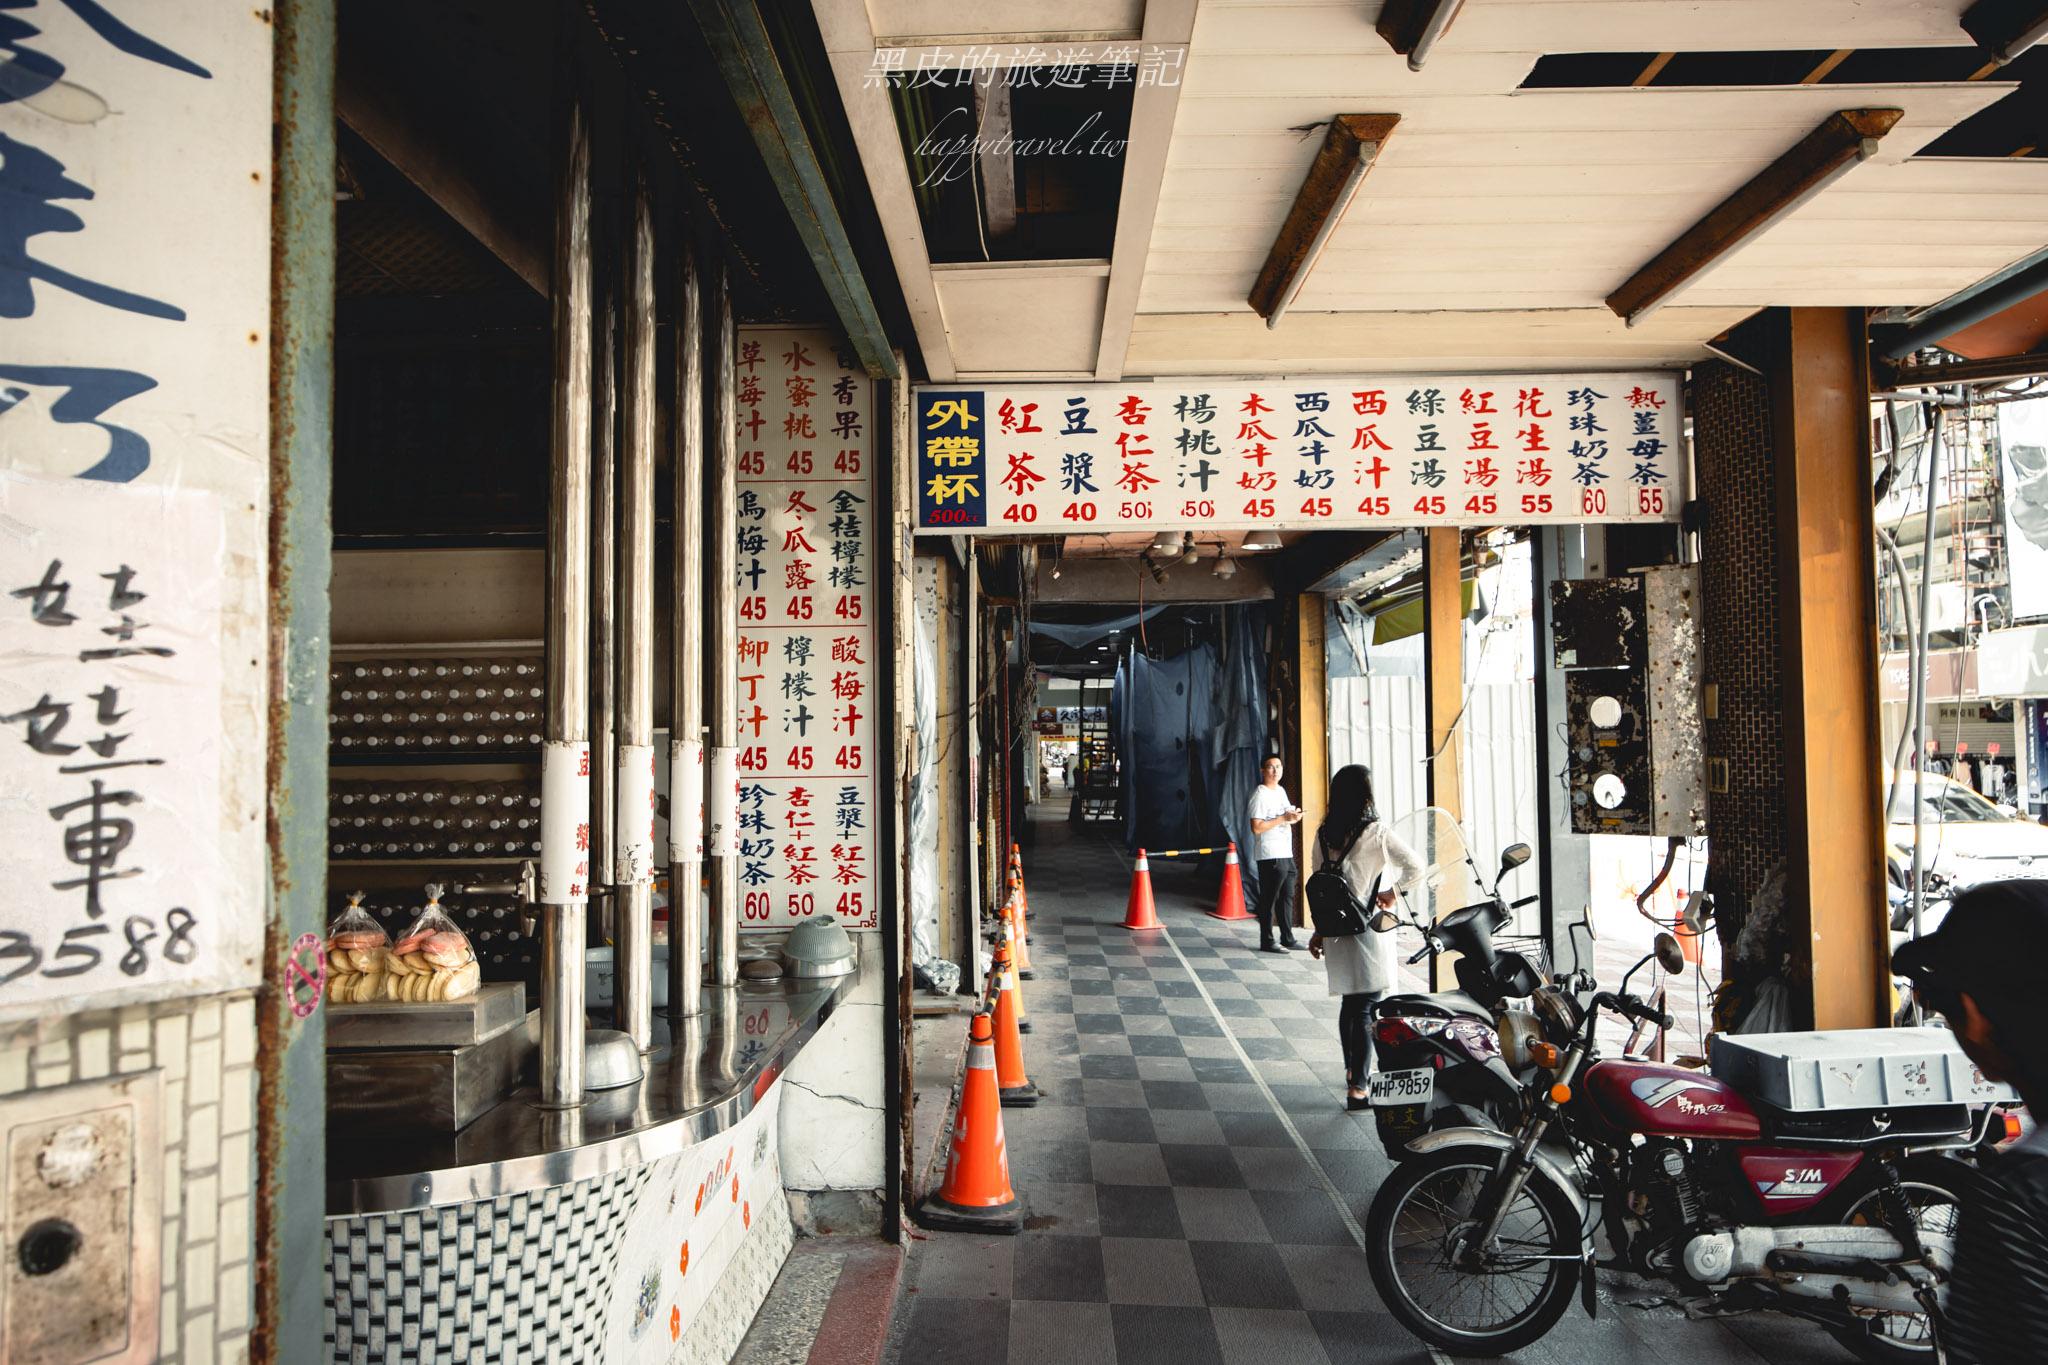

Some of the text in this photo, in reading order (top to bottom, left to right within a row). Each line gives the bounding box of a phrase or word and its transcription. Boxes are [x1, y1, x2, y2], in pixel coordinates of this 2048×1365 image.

[737, 340, 766, 475] 草莓汁 45
[782, 341, 817, 474] 水蜜桃 45
[835, 450, 860, 473] 45
[927, 400, 979, 504] 外帶杯
[998, 398, 1046, 523] 紅茶 40
[1060, 397, 1099, 522] 豆漿 40
[1115, 396, 1160, 519] 杏仁茶 50
[1173, 394, 1221, 518] 楊桃汁 50
[1236, 393, 1277, 518] 木瓜牛奶 45
[1293, 392, 1335, 517] 西瓜牛奶 45
[1351, 390, 1393, 516] 西瓜汁 45
[1405, 389, 1446, 515] 綠豆湯 45
[1460, 389, 1499, 515] 紅豆湯 45
[1514, 388, 1553, 514] 花生湯 55
[1567, 387, 1609, 516] 珍珠奶茶 60
[1624, 387, 1668, 514] 熱薑母茶 55
[737, 489, 768, 620] 烏梅汁 45
[781, 490, 817, 620] 冬瓜露 45
[827, 489, 866, 619] 金桔檸檬 45
[928, 509, 979, 524] 500cc
[0, 558, 176, 919] 娃娃車
[738, 635, 768, 771] 柳丁汁 45
[781, 635, 816, 770] 檸檬汁 45
[831, 634, 866, 769] 酸梅汁 45
[740, 784, 777, 920] 珍珠奶茶 60
[788, 893, 814, 917] 50
[836, 892, 862, 916] 45
